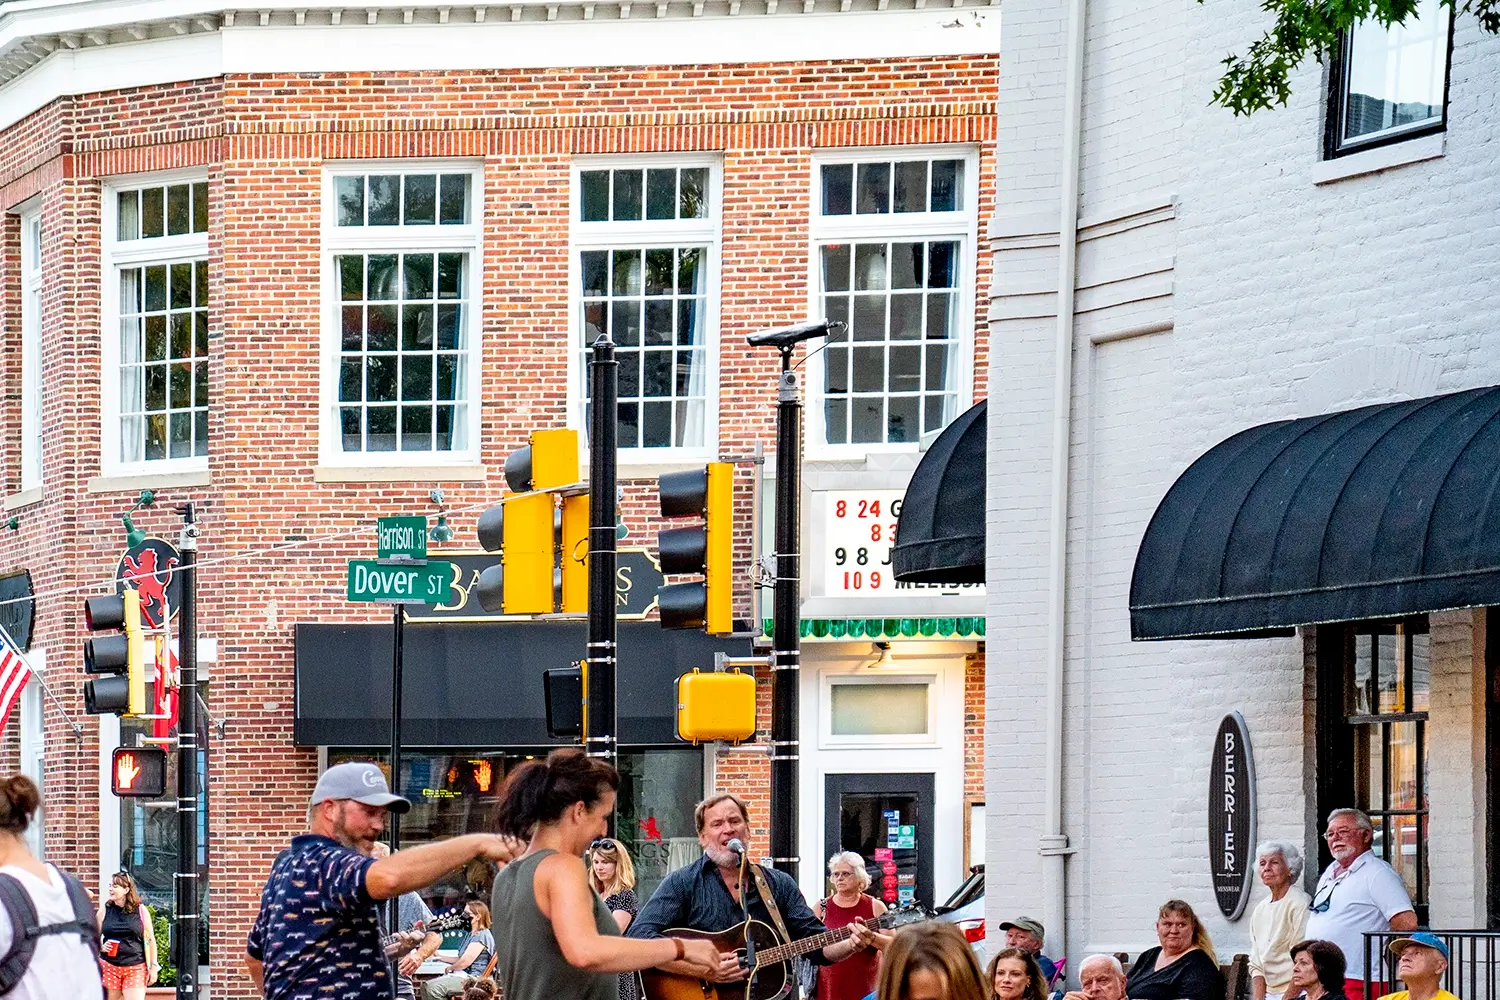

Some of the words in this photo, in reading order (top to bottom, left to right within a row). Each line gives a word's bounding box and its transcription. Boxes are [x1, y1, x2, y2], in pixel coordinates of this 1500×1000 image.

[836, 499, 847, 518] 8
[858, 499, 881, 518] 24
[378, 521, 414, 550] Harrison
[417, 528, 425, 550] ST
[871, 524, 882, 542] 8
[835, 547, 847, 566] 9
[856, 547, 869, 566] 8
[354, 564, 419, 595] Dover
[427, 574, 444, 595] ST
[843, 571, 862, 590] 10
[870, 571, 881, 590] 9
[1224, 732, 1236, 872] BERRIER
